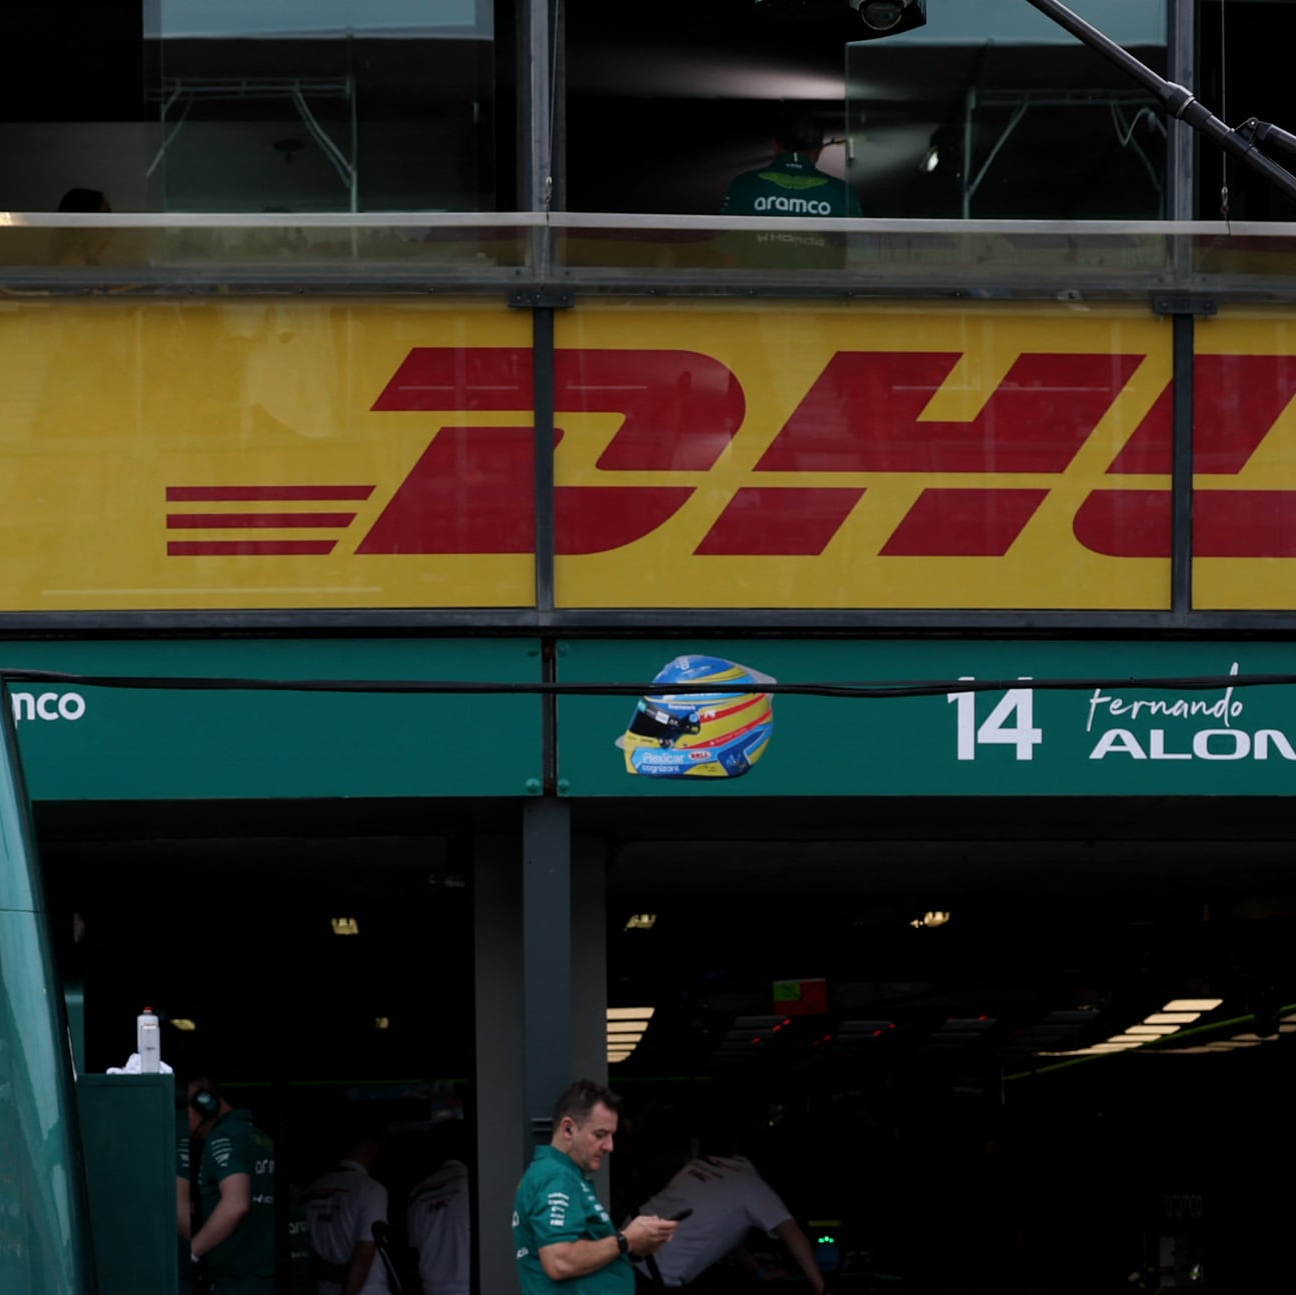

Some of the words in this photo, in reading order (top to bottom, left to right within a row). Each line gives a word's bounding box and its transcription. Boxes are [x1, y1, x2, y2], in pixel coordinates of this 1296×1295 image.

[755, 196, 831, 215] aramco
[947, 677, 1042, 761] 14
[1086, 662, 1243, 732] Fernando
